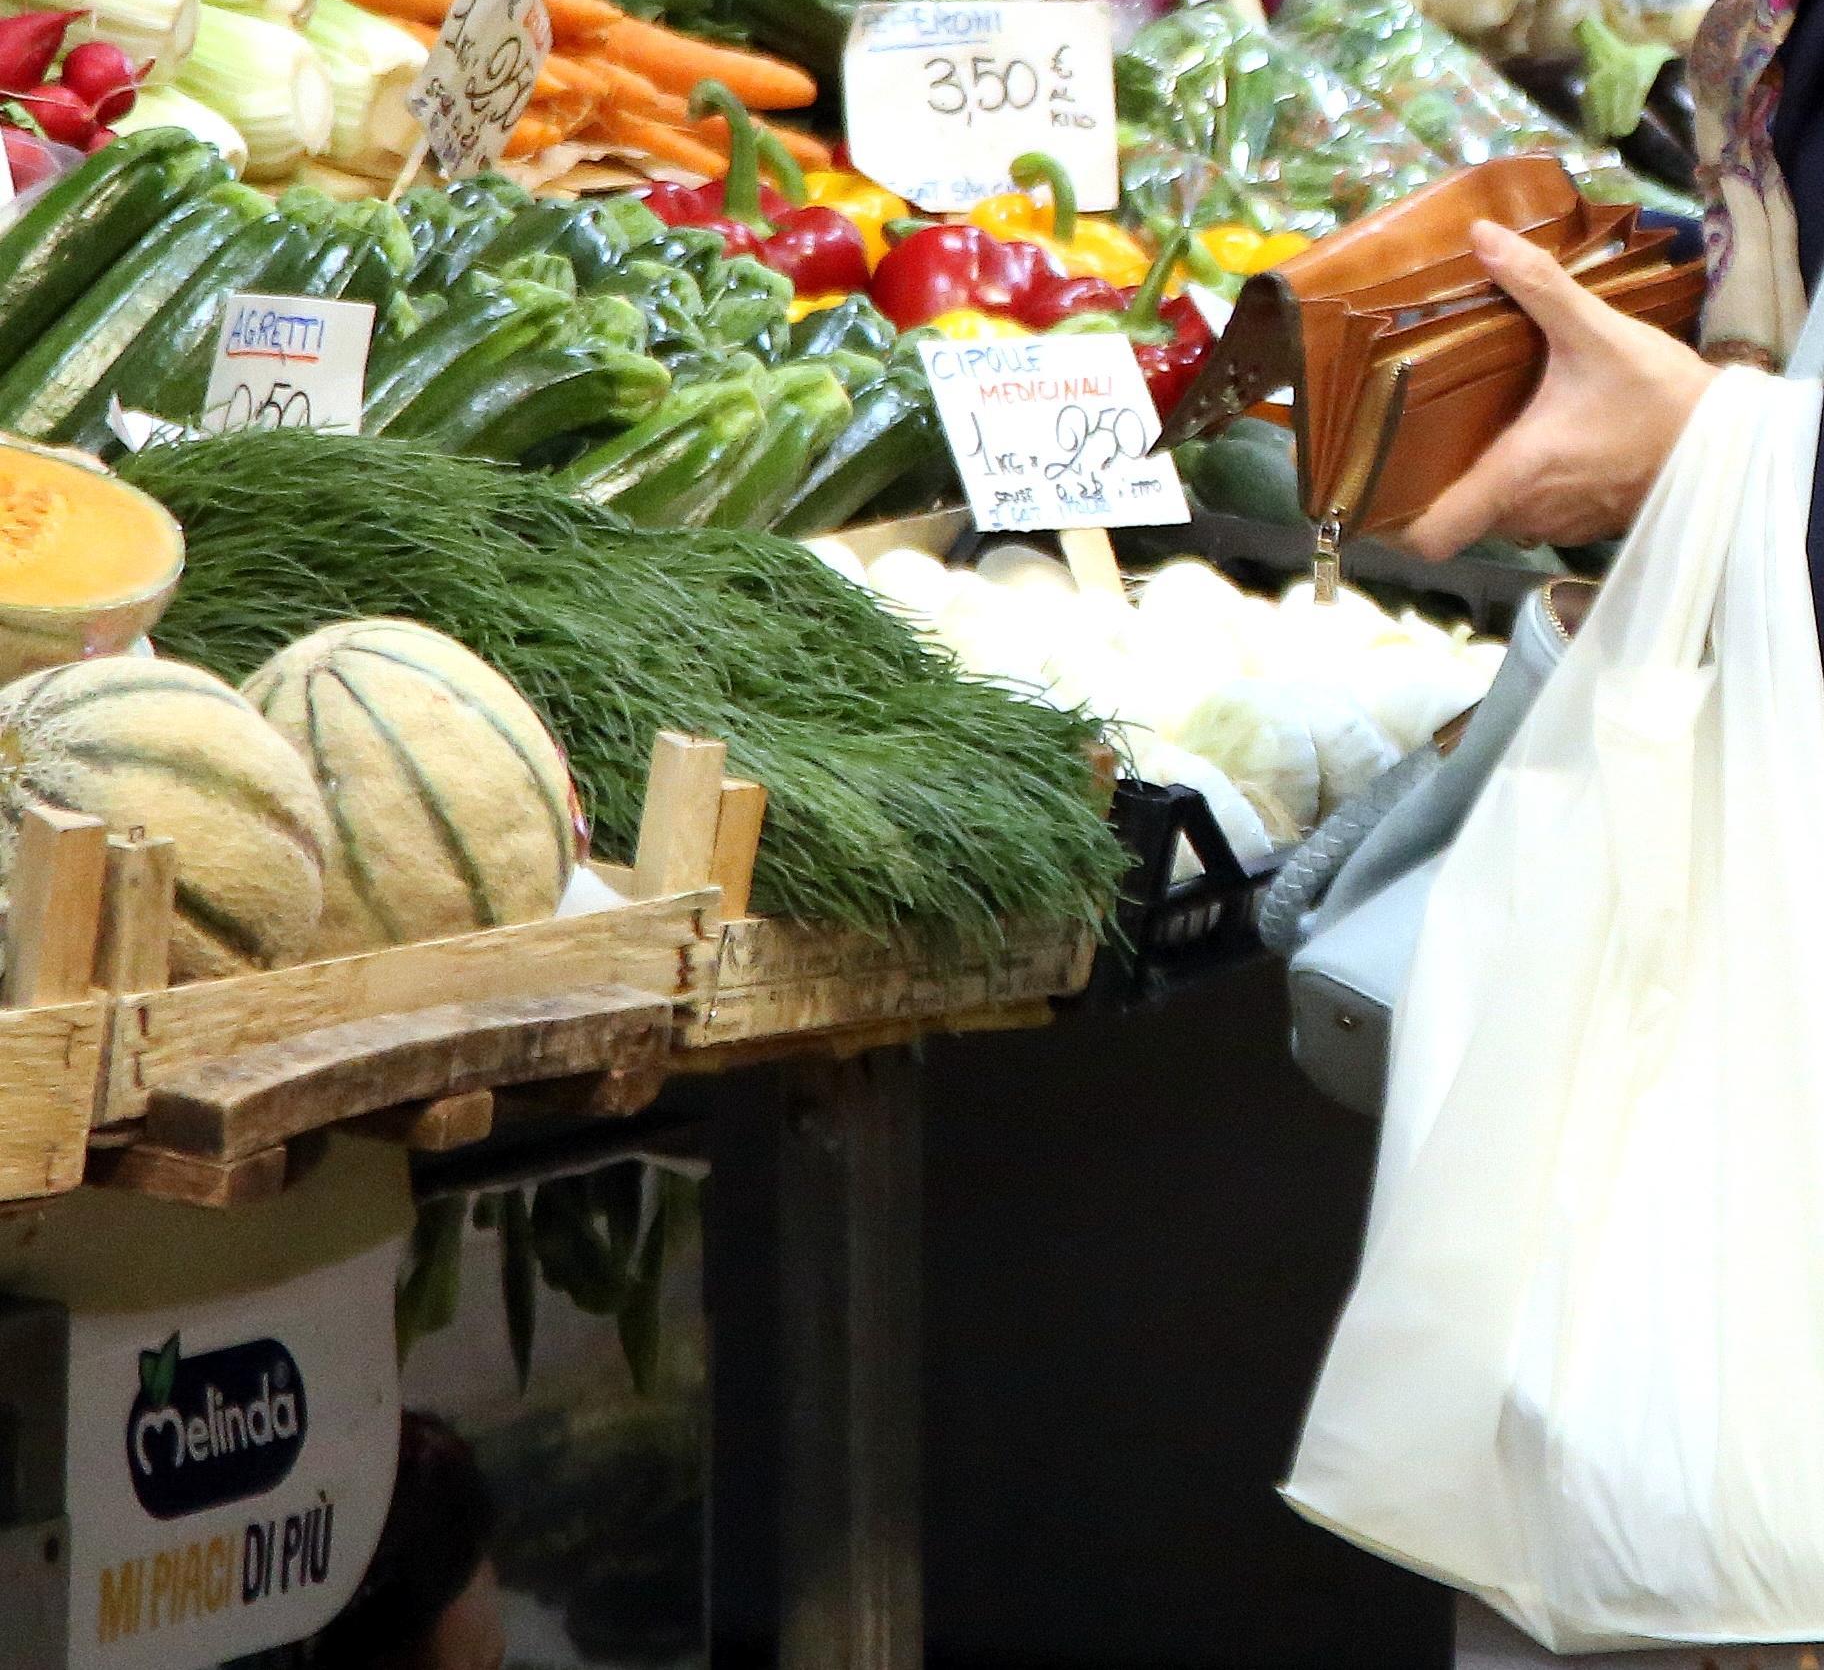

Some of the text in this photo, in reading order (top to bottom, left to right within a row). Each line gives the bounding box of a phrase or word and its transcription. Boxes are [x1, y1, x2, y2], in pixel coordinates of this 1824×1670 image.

[923, 56, 1038, 128] 3,50
[226, 305, 325, 352] AGRETTI
[932, 344, 1045, 380] CIPOLLE
[979, 376, 1112, 405] MEDICINALI
[1044, 404, 1148, 481] 2,50
[135, 1372, 298, 1476] Melinda
[99, 1488, 336, 1644] MI PIACI DI PIÙ
